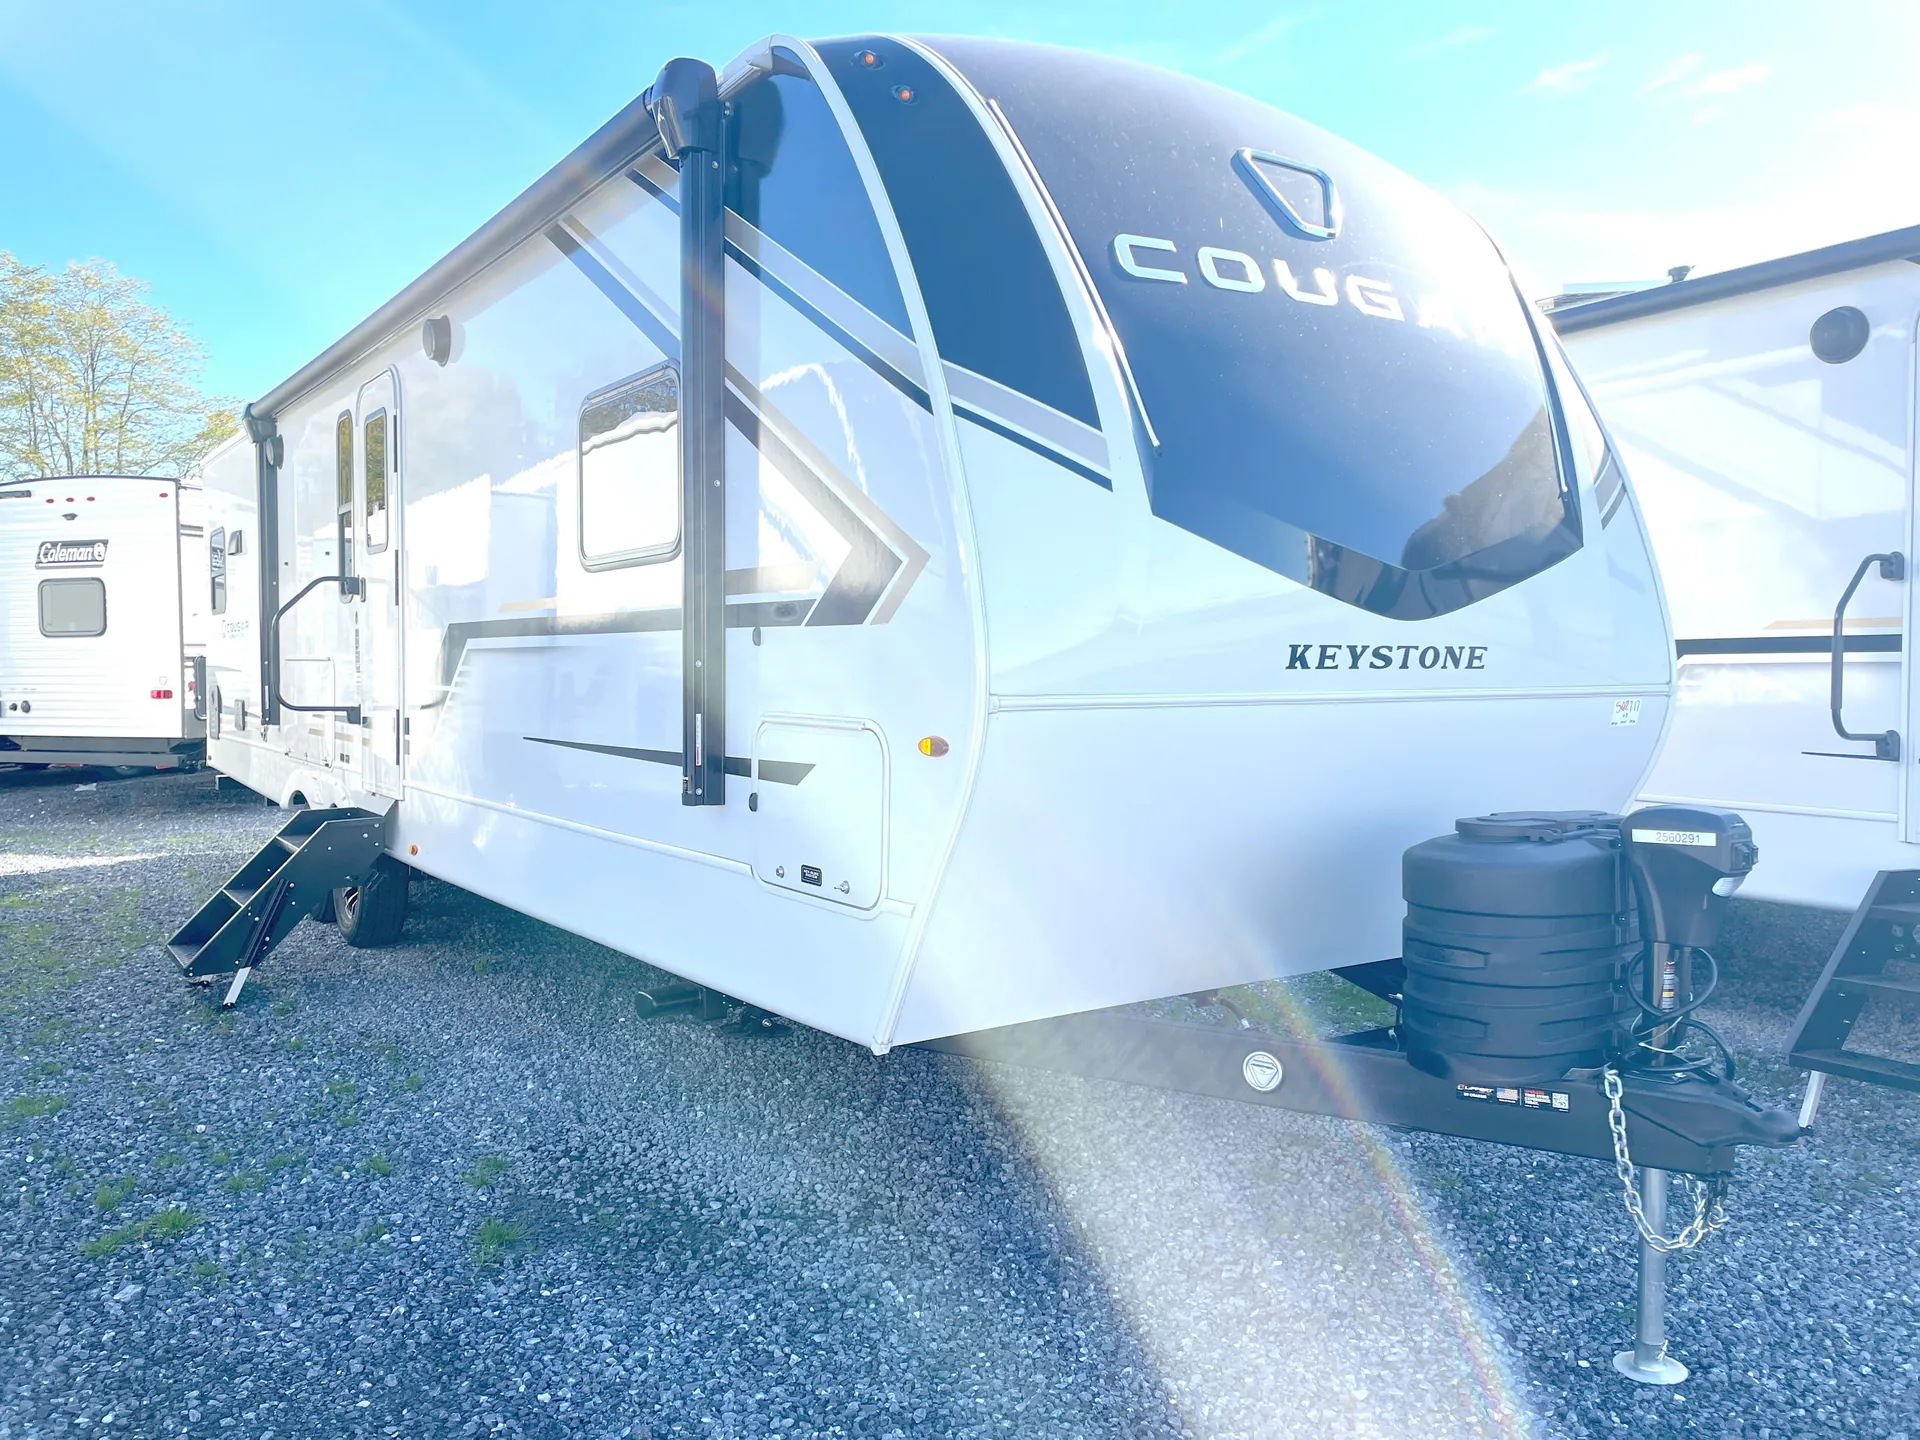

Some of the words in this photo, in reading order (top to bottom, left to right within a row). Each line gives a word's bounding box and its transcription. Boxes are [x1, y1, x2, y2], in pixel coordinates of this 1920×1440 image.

[1113, 233, 1503, 348] COUG
[40, 542, 93, 563] Coleman
[1285, 644, 1489, 670] KEYSTONE
[1655, 832, 1701, 844] 2560291
